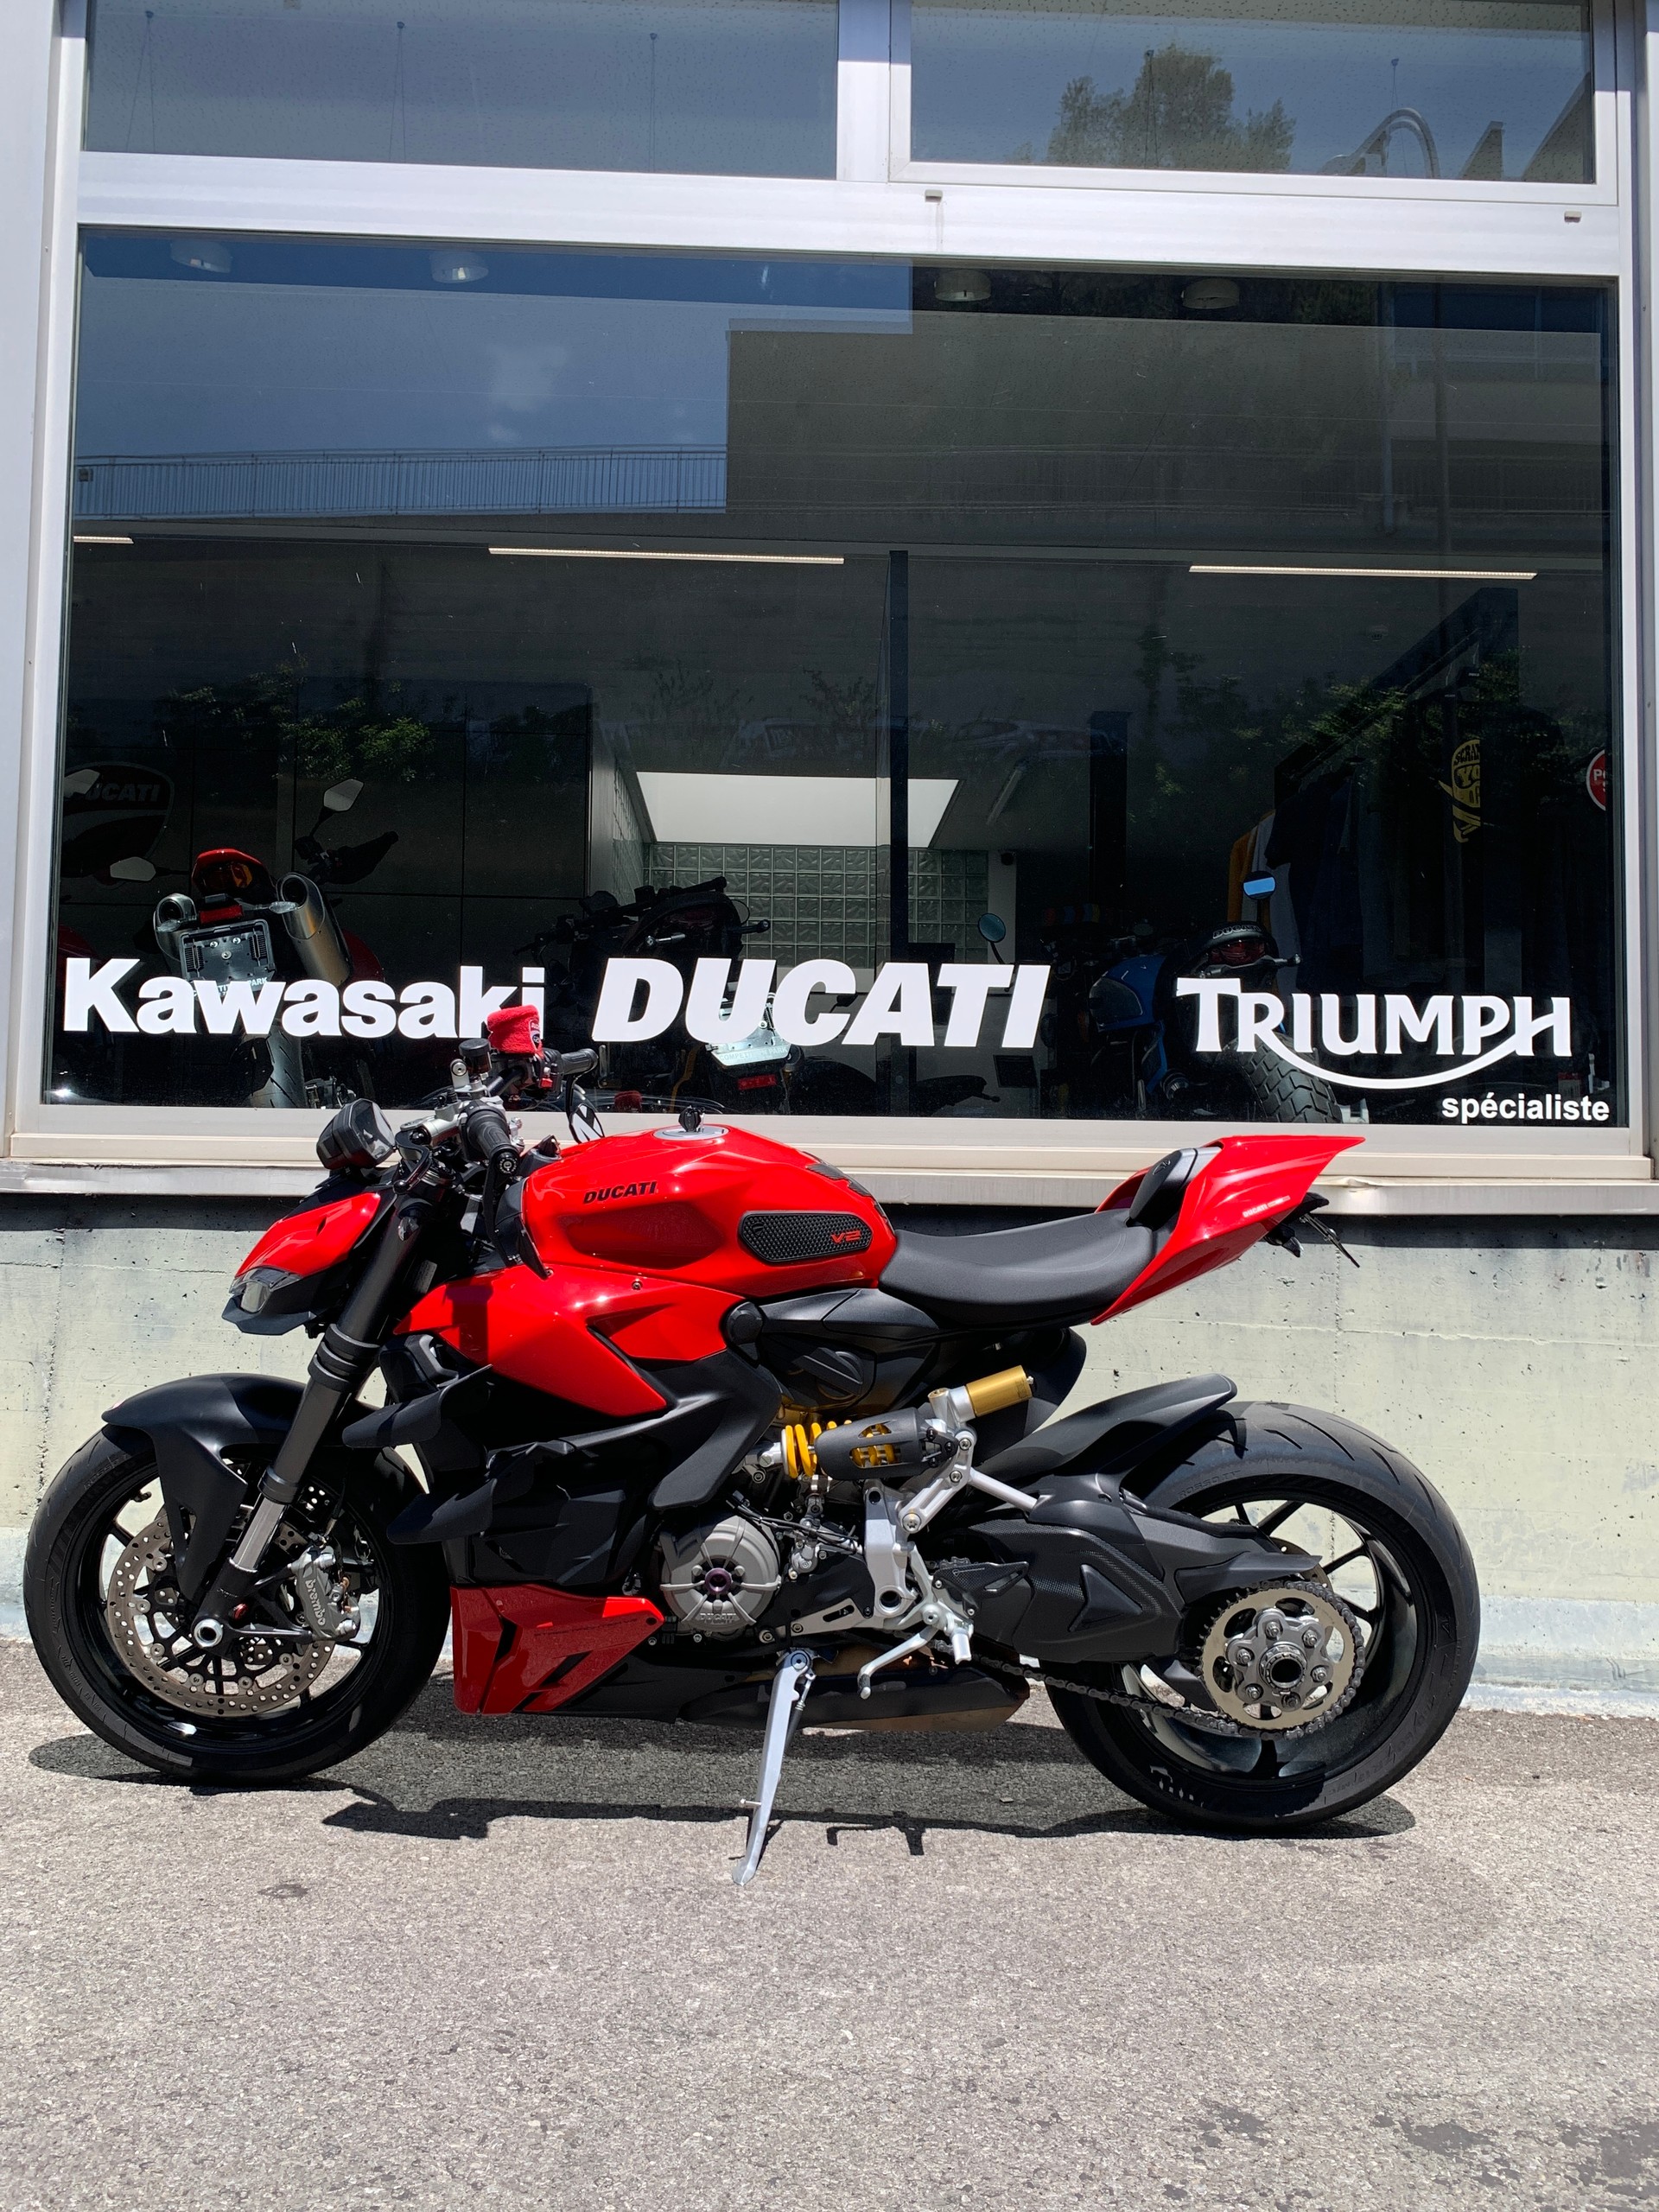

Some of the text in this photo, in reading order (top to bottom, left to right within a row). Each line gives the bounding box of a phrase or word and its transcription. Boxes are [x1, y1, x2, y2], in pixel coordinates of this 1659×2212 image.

[85, 782, 160, 802] UCATI
[64, 957, 544, 1039] Kawasaki
[592, 957, 1051, 1048] DUCATI
[1176, 977, 1572, 1089] TRIUMPH
[1442, 1092, 1610, 1124] spécialiste
[582, 1181, 658, 1205] DUCATI
[830, 1230, 861, 1243] V2
[305, 1579, 326, 1626] brembo
